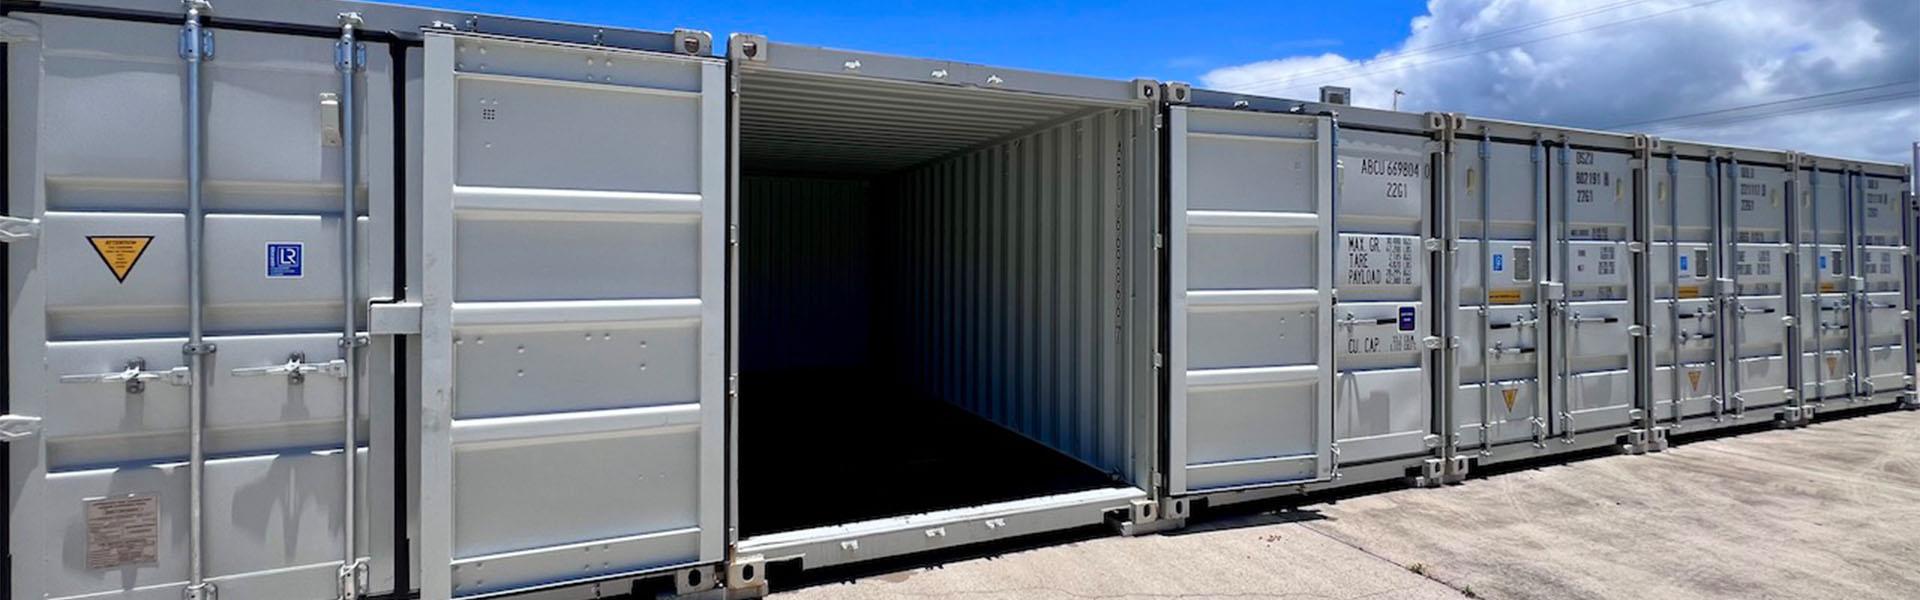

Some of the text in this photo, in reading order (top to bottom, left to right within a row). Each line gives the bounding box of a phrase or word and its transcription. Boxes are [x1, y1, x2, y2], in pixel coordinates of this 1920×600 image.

[1361, 159, 1385, 175] ABCU
[1387, 161, 1419, 177] 669804
[1387, 182, 1407, 198] 22G1
[281, 248, 296, 264] LR
[1349, 253, 1368, 268] TARE
[1348, 269, 1381, 284] PAYLOAD
